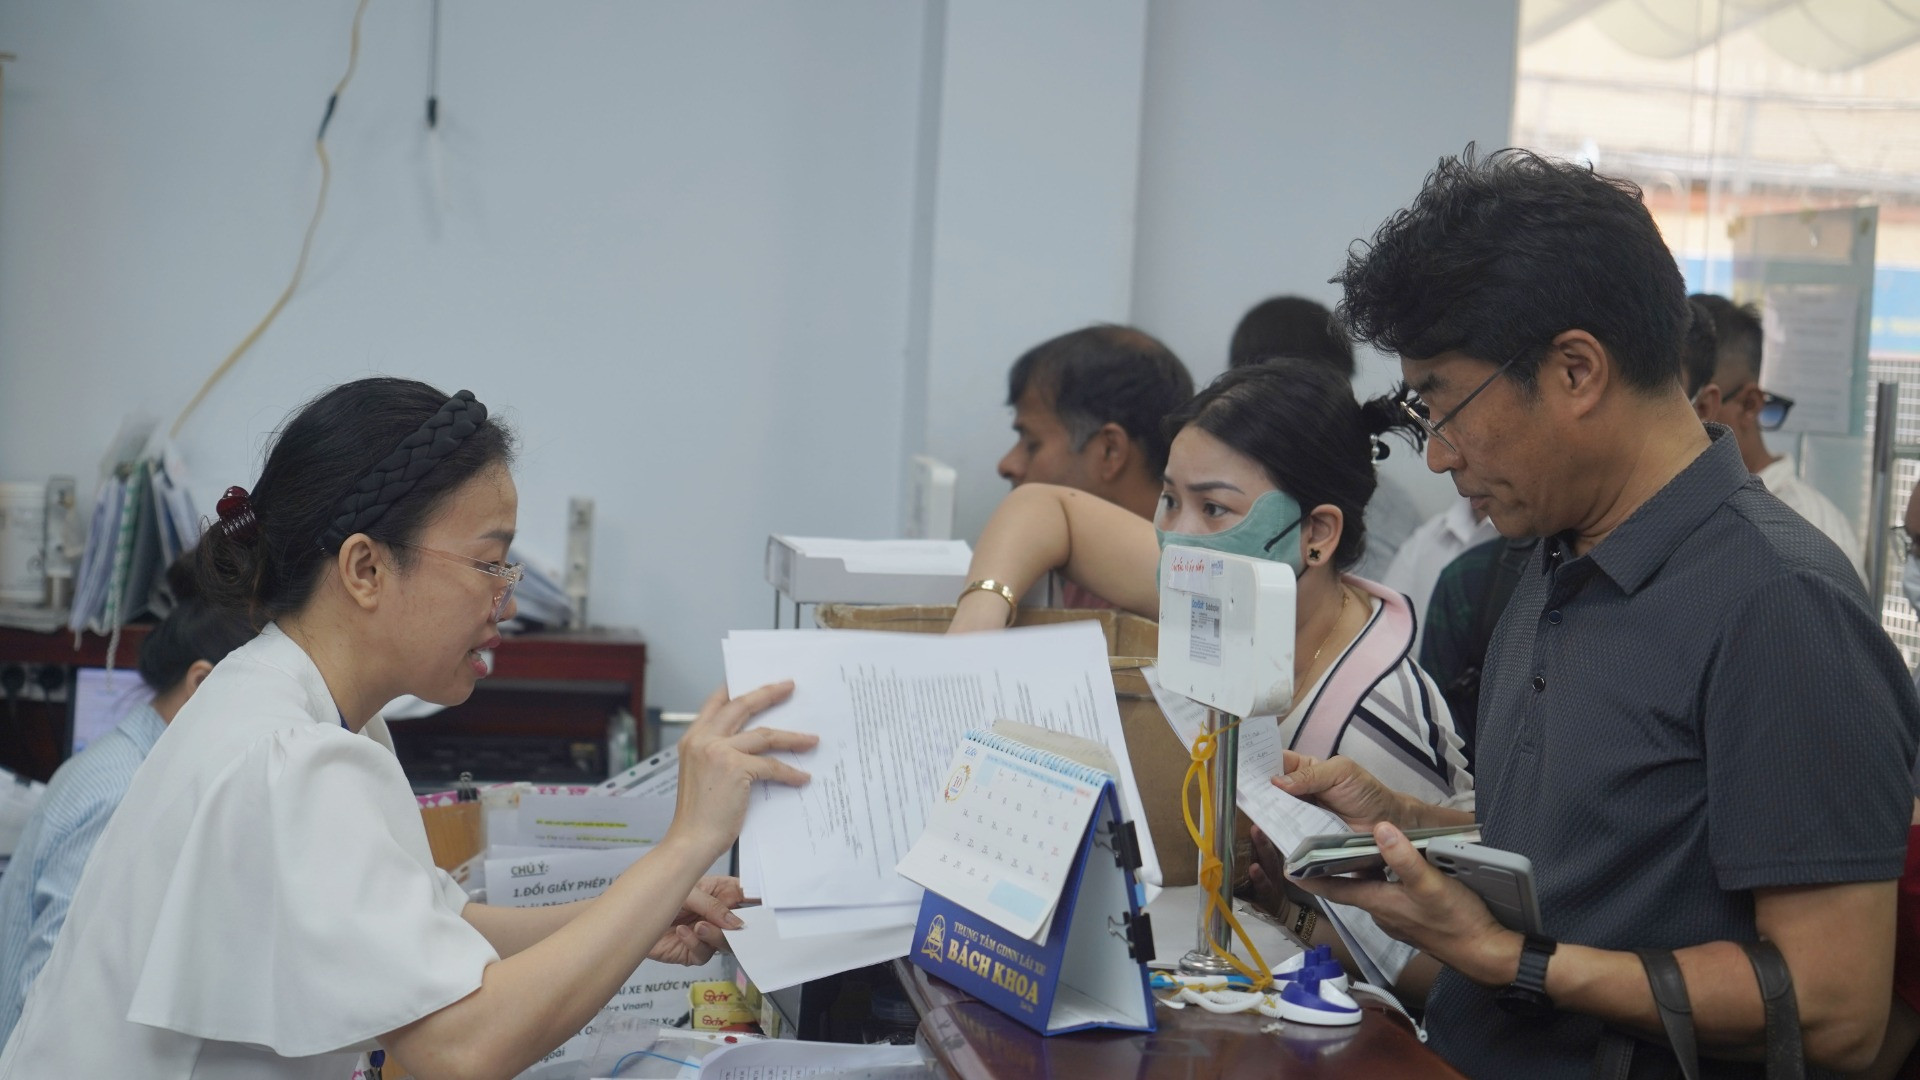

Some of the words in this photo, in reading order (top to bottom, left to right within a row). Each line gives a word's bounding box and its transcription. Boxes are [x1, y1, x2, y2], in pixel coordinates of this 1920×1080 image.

[577, 878, 606, 891] PHÉP
[953, 921, 980, 943] TRUNG
[980, 934, 996, 952] TÂM
[946, 938, 992, 979] BÁCH
[992, 962, 1039, 1005] KHOA
[629, 985, 641, 995] XE
[622, 1000, 653, 1012] Vnam)
